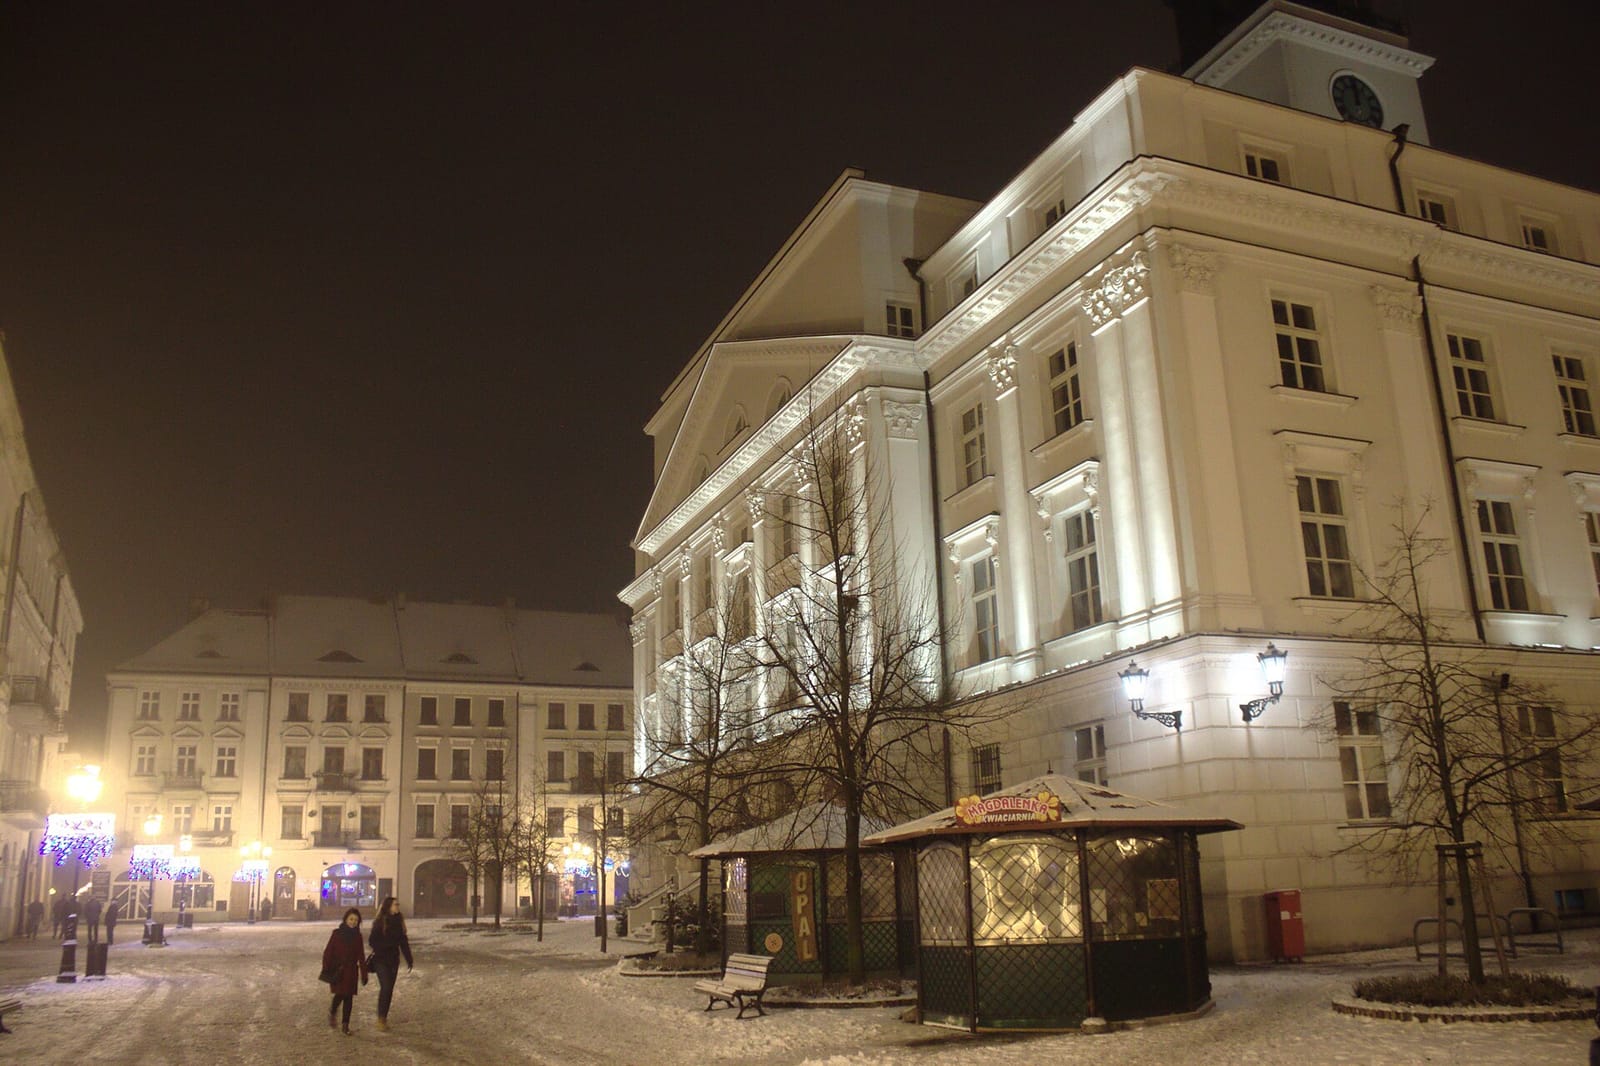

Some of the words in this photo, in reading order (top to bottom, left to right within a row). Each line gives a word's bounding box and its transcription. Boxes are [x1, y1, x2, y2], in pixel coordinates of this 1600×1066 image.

[967, 797, 1049, 818] MAGDALENKA
[981, 812, 1036, 823] KWIACIARNIA
[795, 871, 813, 960] OPAL
